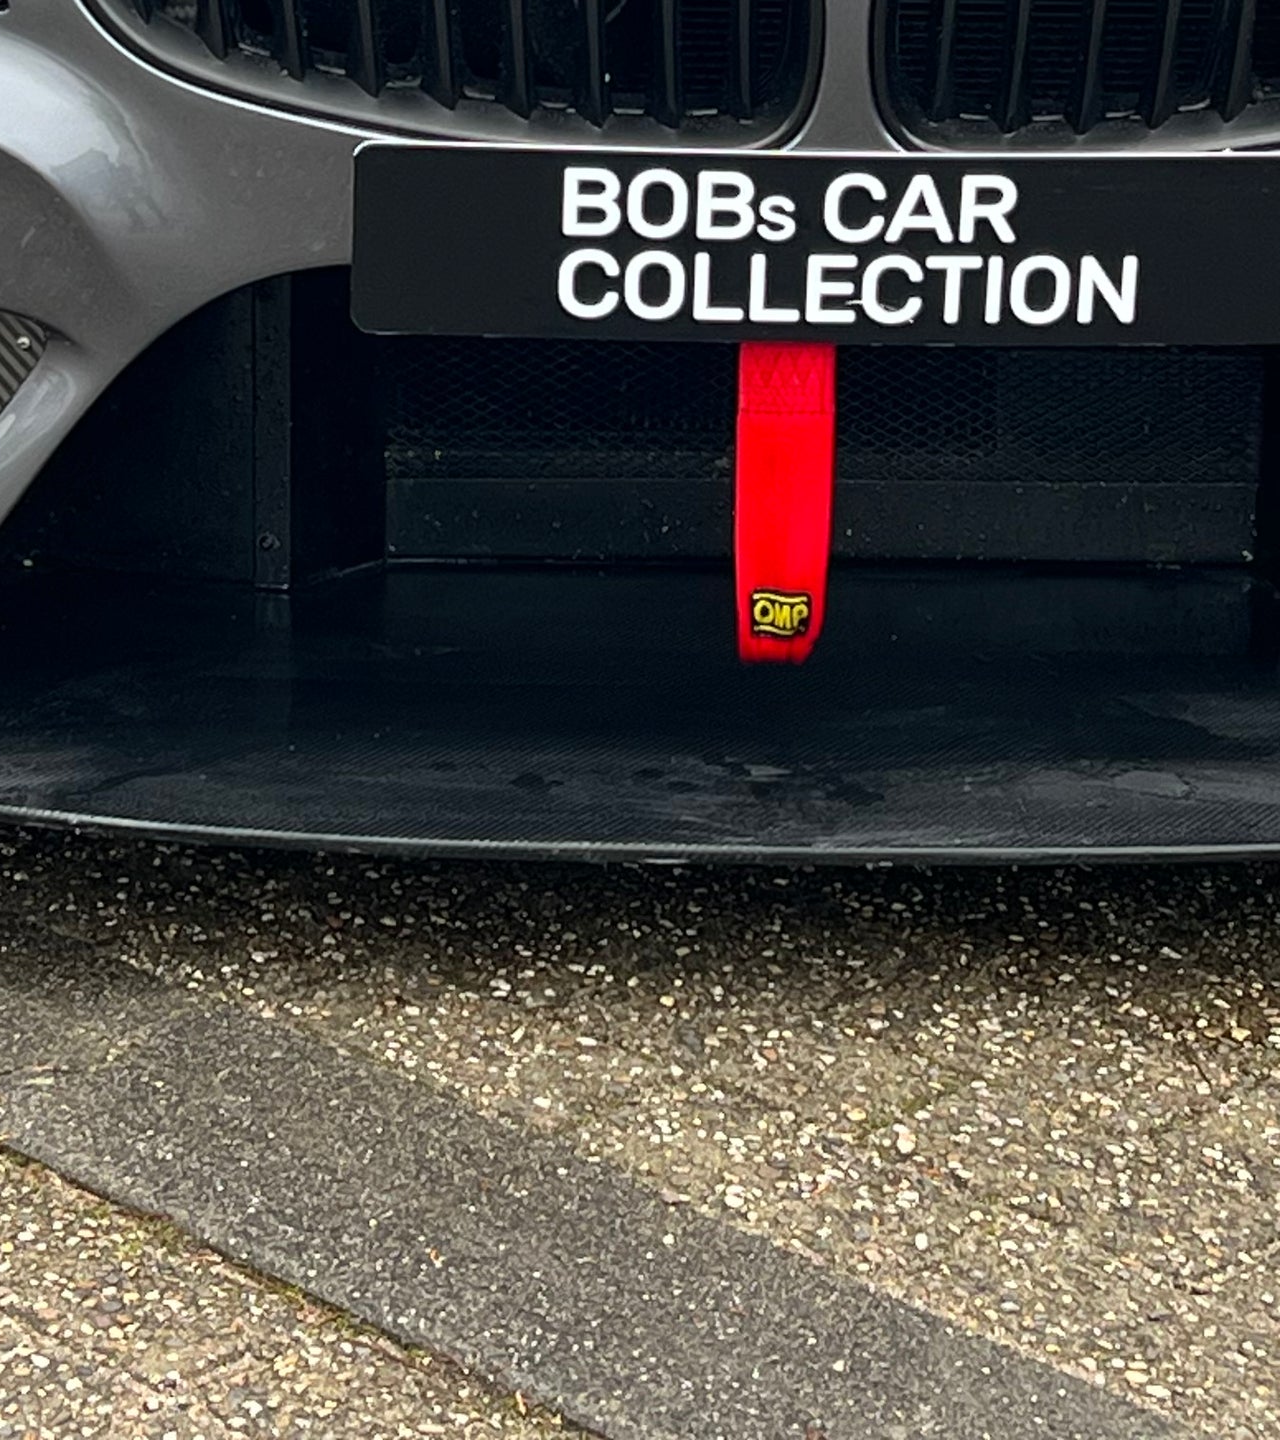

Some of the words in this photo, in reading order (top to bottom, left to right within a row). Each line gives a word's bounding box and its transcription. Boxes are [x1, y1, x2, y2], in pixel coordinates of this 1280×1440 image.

[561, 166, 797, 242] BOBs
[823, 173, 1019, 244] CAR
[557, 248, 1139, 326] COLLECTION
[753, 599, 809, 630] OMP
